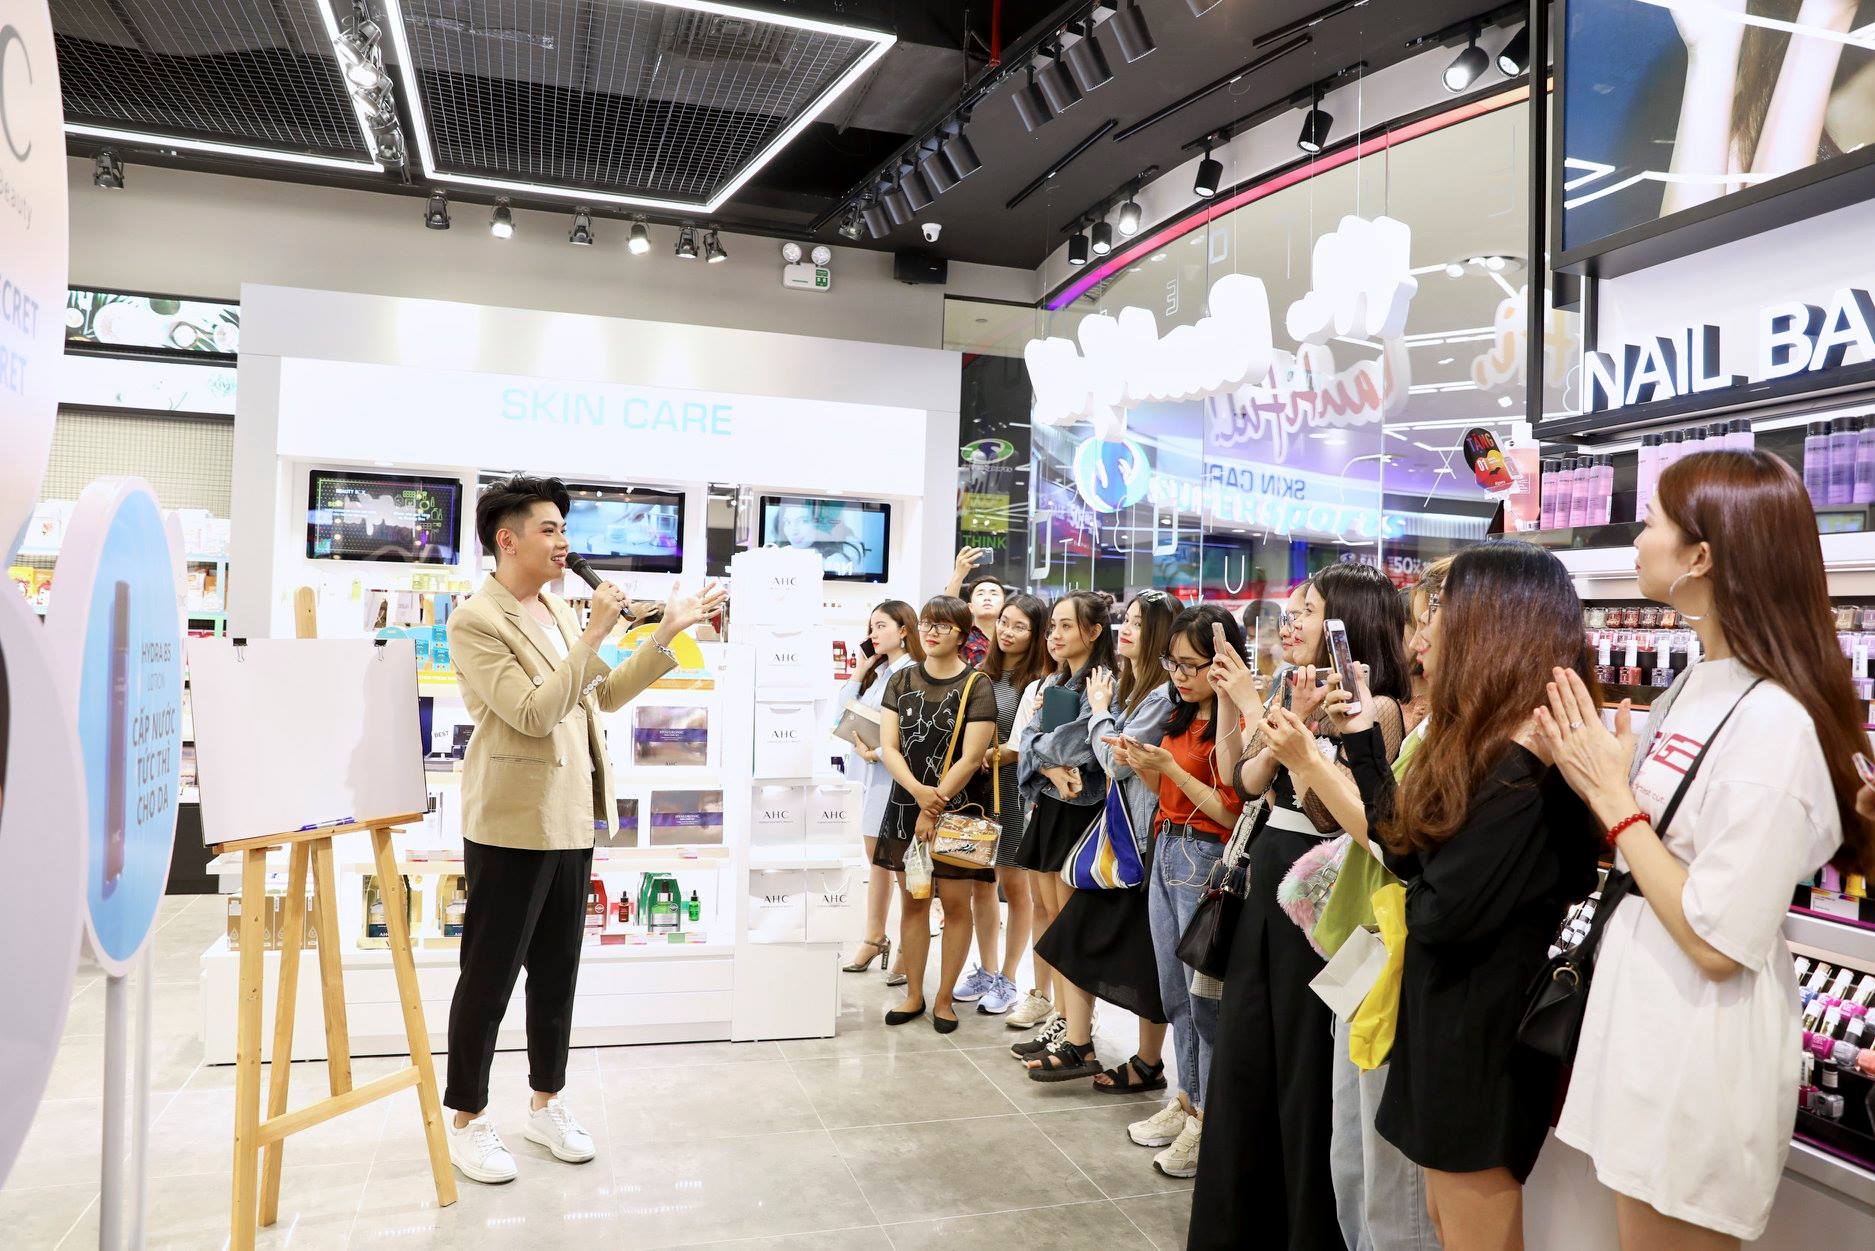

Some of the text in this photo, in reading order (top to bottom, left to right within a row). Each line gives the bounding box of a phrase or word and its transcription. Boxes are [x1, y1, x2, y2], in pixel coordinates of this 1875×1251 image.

[0, 272, 39, 340] CRET
[1583, 320, 1744, 414] NAIL
[501, 386, 735, 436] SKIN CARE
[962, 534, 1008, 550] THINK
[771, 577, 797, 586] AHC
[141, 643, 163, 664] HYDRA
[772, 653, 799, 662] AHC
[771, 730, 798, 739] AHC
[136, 783, 169, 825] CHO DA
[764, 810, 789, 819] AHC
[821, 810, 848, 819] AHC
[764, 894, 789, 903] AHC
[822, 894, 848, 903] AHC
